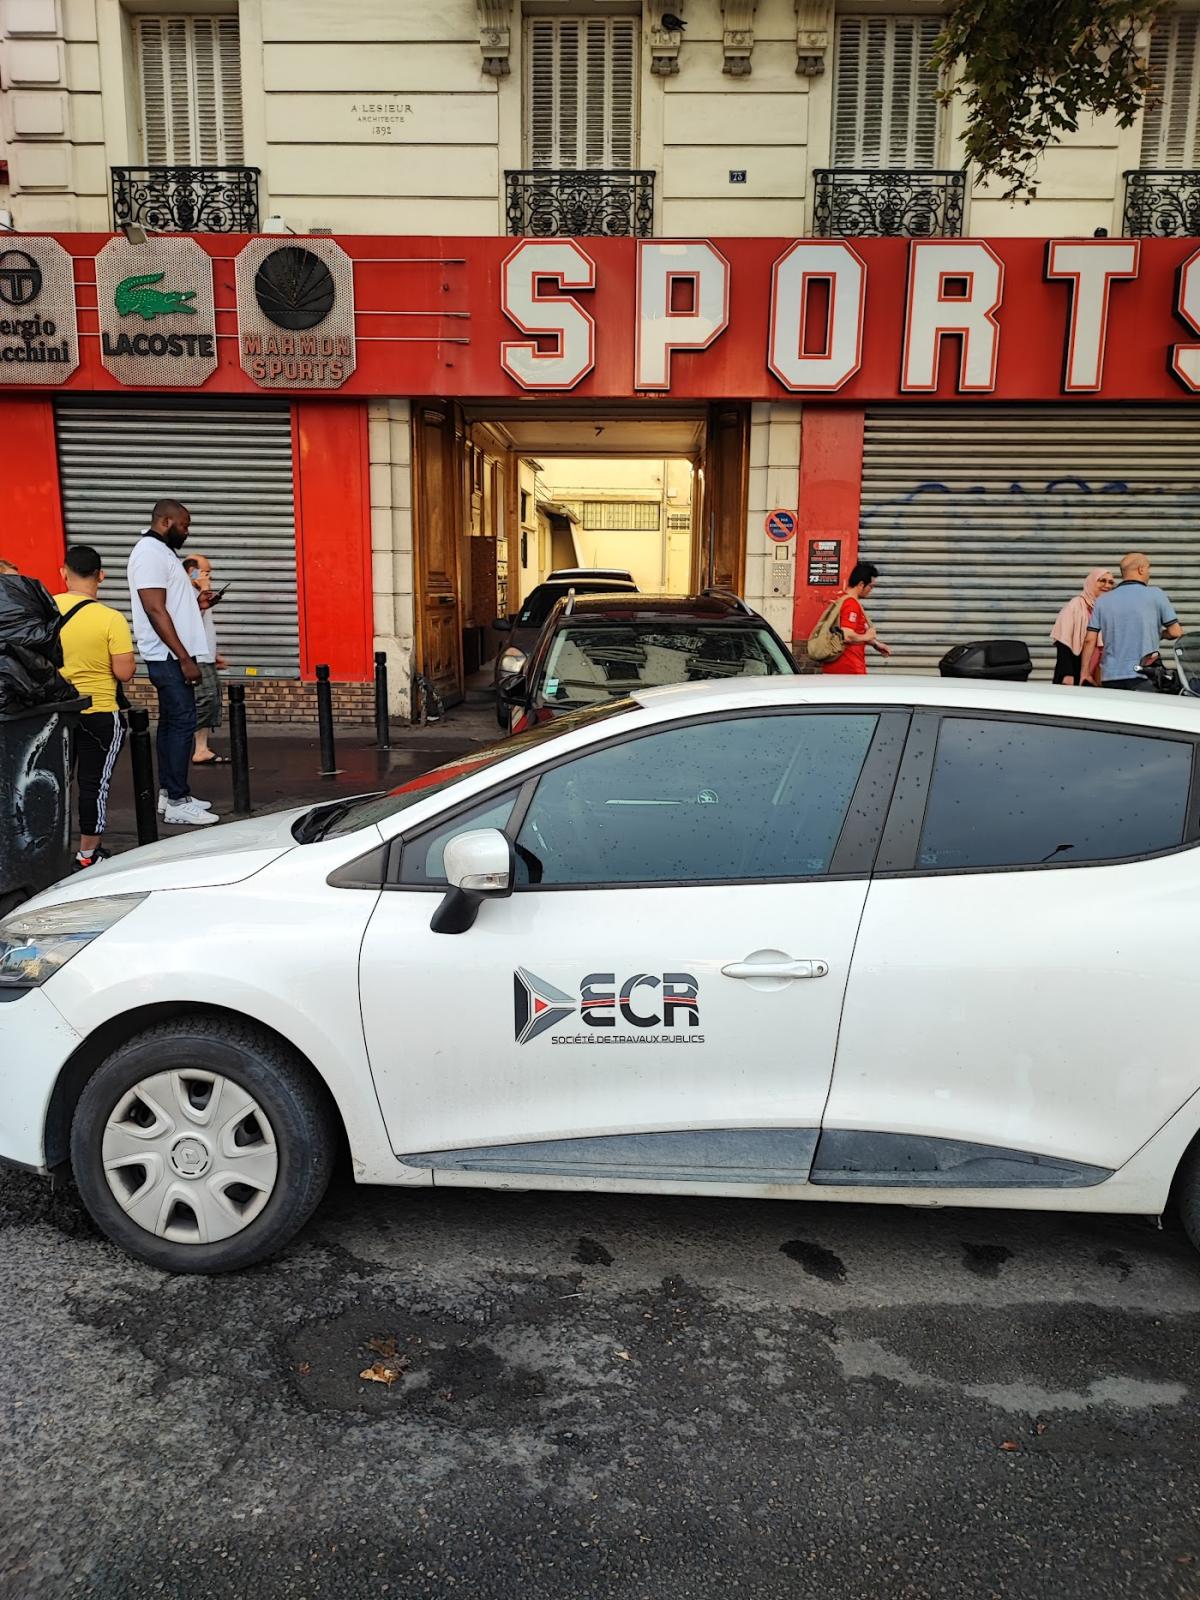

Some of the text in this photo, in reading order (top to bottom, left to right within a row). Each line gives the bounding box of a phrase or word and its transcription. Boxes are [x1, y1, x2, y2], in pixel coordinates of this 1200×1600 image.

[362, 104, 414, 114] LESIEUR
[0, 313, 56, 340] ergio
[0, 340, 71, 363] cchini
[101, 333, 215, 357] LACOSTE
[243, 334, 351, 356] MARMON
[252, 359, 344, 380] SPORTS
[580, 973, 699, 1027] ECR
[551, 1033, 705, 1045] SOCIÉTÉ DE TRAVAUX PUBLICS
